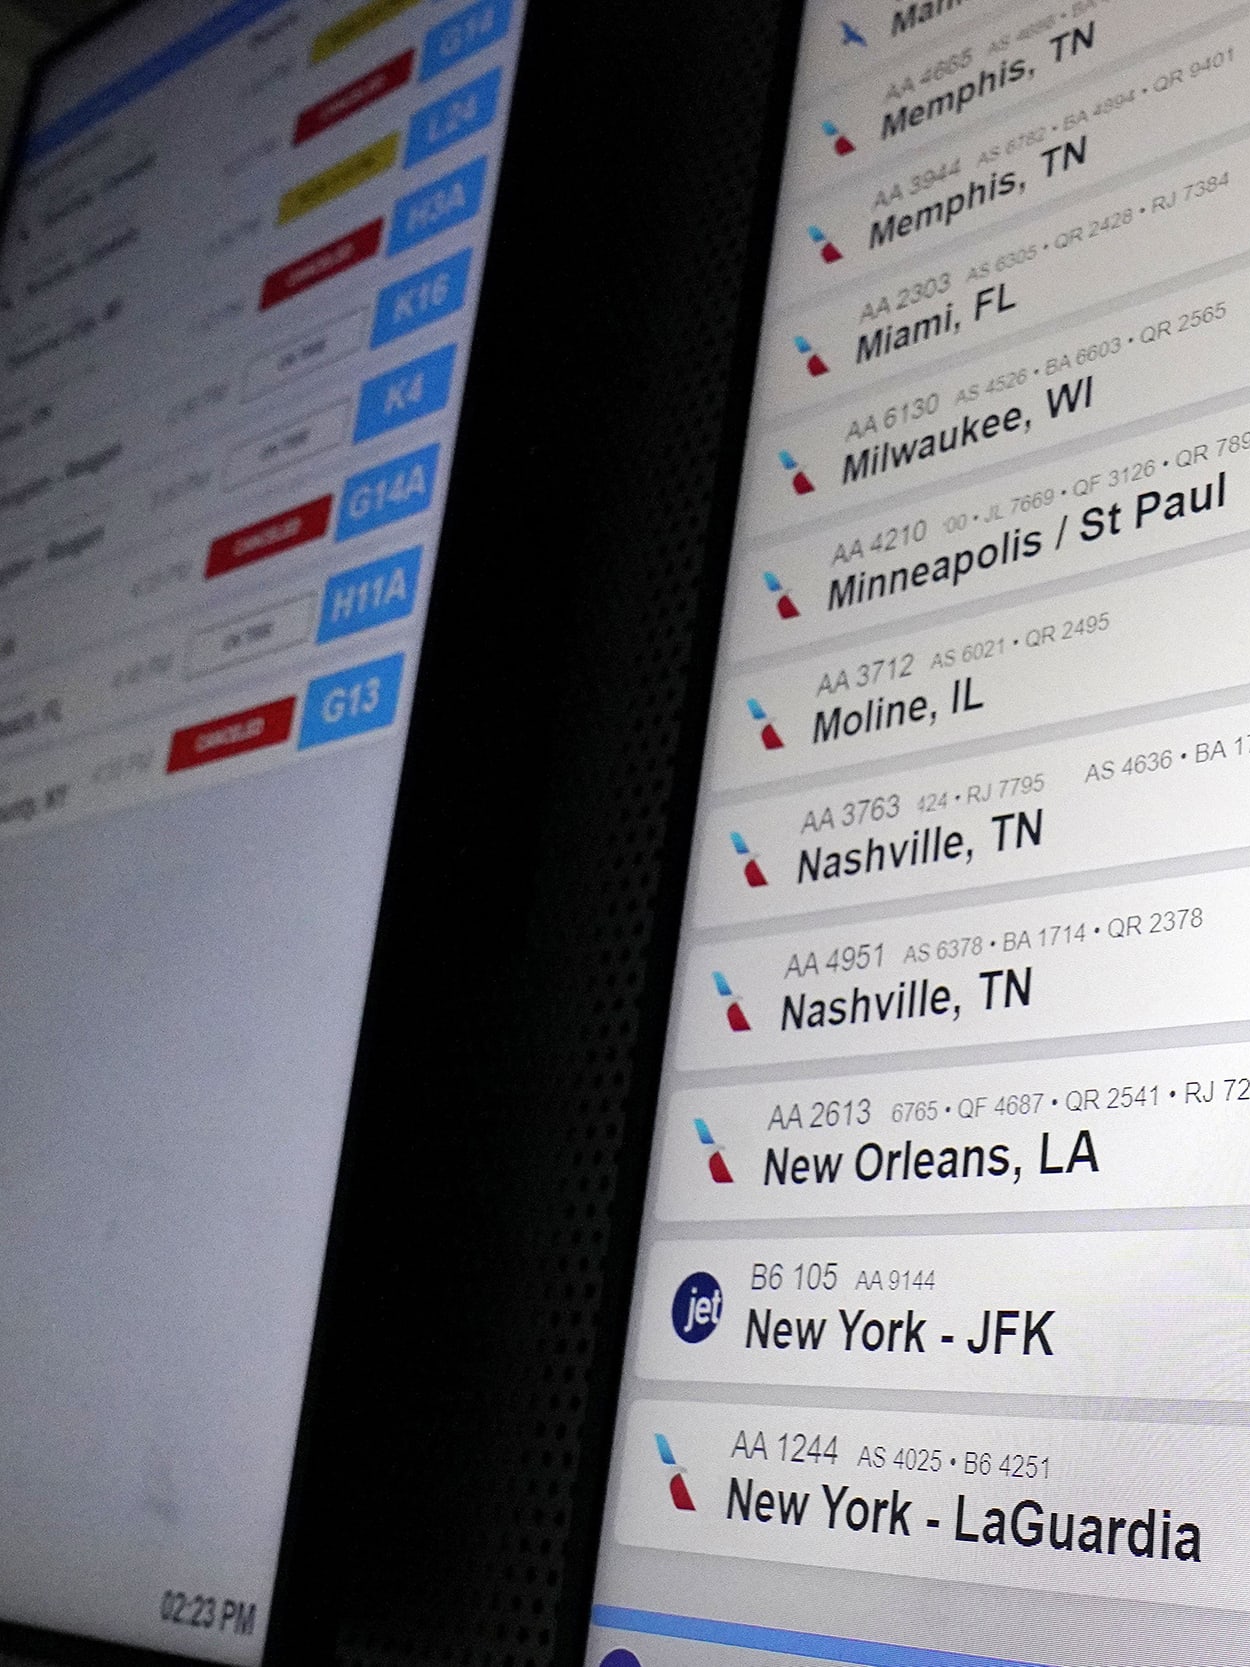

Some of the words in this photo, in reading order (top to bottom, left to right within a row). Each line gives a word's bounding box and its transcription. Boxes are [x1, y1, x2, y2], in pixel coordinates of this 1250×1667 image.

[881, 57, 1035, 139] Memphis,
[1049, 21, 1094, 62] TN
[873, 187, 901, 209] AA
[1152, 66, 1185, 95] QR
[1190, 47, 1235, 82] 9401
[869, 170, 1026, 249] Memphis,
[1041, 135, 1087, 178] TN
[858, 297, 890, 324] AA
[896, 273, 951, 311] 2303
[965, 263, 990, 282] AS
[1054, 226, 1083, 250] QR
[1088, 209, 1132, 239] 2428
[1151, 193, 1177, 215] RJ
[1184, 172, 1230, 203] 7384
[856, 302, 960, 364] Miami,
[974, 284, 1016, 321] FL
[845, 414, 878, 442] AA
[883, 392, 939, 431] 6130
[954, 384, 980, 406] AS
[984, 368, 1027, 397] 4526
[1045, 354, 1072, 375] BA
[1075, 336, 1122, 367] 6603
[1139, 321, 1171, 344] QR
[1178, 302, 1227, 333] 2565
[841, 404, 1032, 485] Milwaukee,
[1046, 375, 1093, 418] WI
[349, 464, 426, 520] G14A
[830, 541, 864, 567] AA
[869, 518, 928, 554] 4210
[984, 502, 1004, 524] JL
[1010, 488, 1055, 514] 7669
[1072, 475, 1101, 498] QF
[1108, 459, 1155, 488] 3126
[1175, 444, 1208, 468] QR
[827, 529, 1042, 611] Minneapolis
[1079, 503, 1122, 543] St
[1135, 471, 1226, 529] Paul
[331, 567, 407, 624] H11A
[816, 672, 849, 697] AA
[856, 653, 914, 688] 3712
[930, 650, 957, 670] AS
[962, 637, 1005, 664] 6021
[1025, 625, 1056, 648] QR
[1060, 611, 1110, 641] 2495
[321, 676, 380, 724] G13
[812, 695, 937, 744] Moline,
[951, 676, 984, 714] IL
[801, 810, 834, 834] AA
[841, 794, 900, 825] 3763
[967, 784, 993, 805] RJ
[999, 772, 1045, 799] 7795
[1084, 760, 1115, 783] AS
[1121, 749, 1172, 777] 4636
[1195, 741, 1226, 764] BA
[797, 825, 973, 884] Nashville,
[991, 808, 1044, 852] TN
[784, 954, 820, 979] AA
[825, 942, 885, 973] 4951
[903, 944, 931, 965] AS
[936, 936, 983, 960] 6378
[1003, 932, 1031, 953] BA
[1038, 923, 1086, 948] 1714
[1108, 915, 1142, 938] QR
[1149, 906, 1204, 935] 2378
[781, 979, 961, 1031] Nashville,
[978, 966, 1033, 1011] TN
[767, 1104, 803, 1131] AA
[810, 1098, 872, 1128] 2613
[891, 1099, 938, 1123] 6765
[958, 1096, 988, 1120] QF
[994, 1092, 1044, 1116] 4687
[1065, 1089, 1100, 1112] QR
[1106, 1085, 1160, 1109] 2541
[1185, 1080, 1215, 1105] RJ
[763, 1147, 843, 1186] New
[854, 1138, 1023, 1184] Orleans,
[1039, 1129, 1099, 1175] LA
[684, 1287, 722, 1333] jet
[751, 1263, 783, 1291] B6
[795, 1263, 838, 1291] 105
[855, 1269, 883, 1291] AA
[888, 1270, 936, 1291] 9144
[745, 1308, 827, 1350] New
[839, 1309, 927, 1353] York
[967, 1310, 1057, 1356] JFK
[731, 1430, 767, 1460] AA
[777, 1433, 839, 1465] 1244
[857, 1445, 887, 1469] AS
[893, 1446, 943, 1473] 4025
[963, 1451, 991, 1476] B6
[999, 1454, 1051, 1480] 4251
[726, 1477, 810, 1527] New
[821, 1484, 911, 1536] York
[955, 1494, 1201, 1562] LaGuardia
[160, 1589, 216, 1628] 02:23
[220, 1599, 257, 1635] PM
